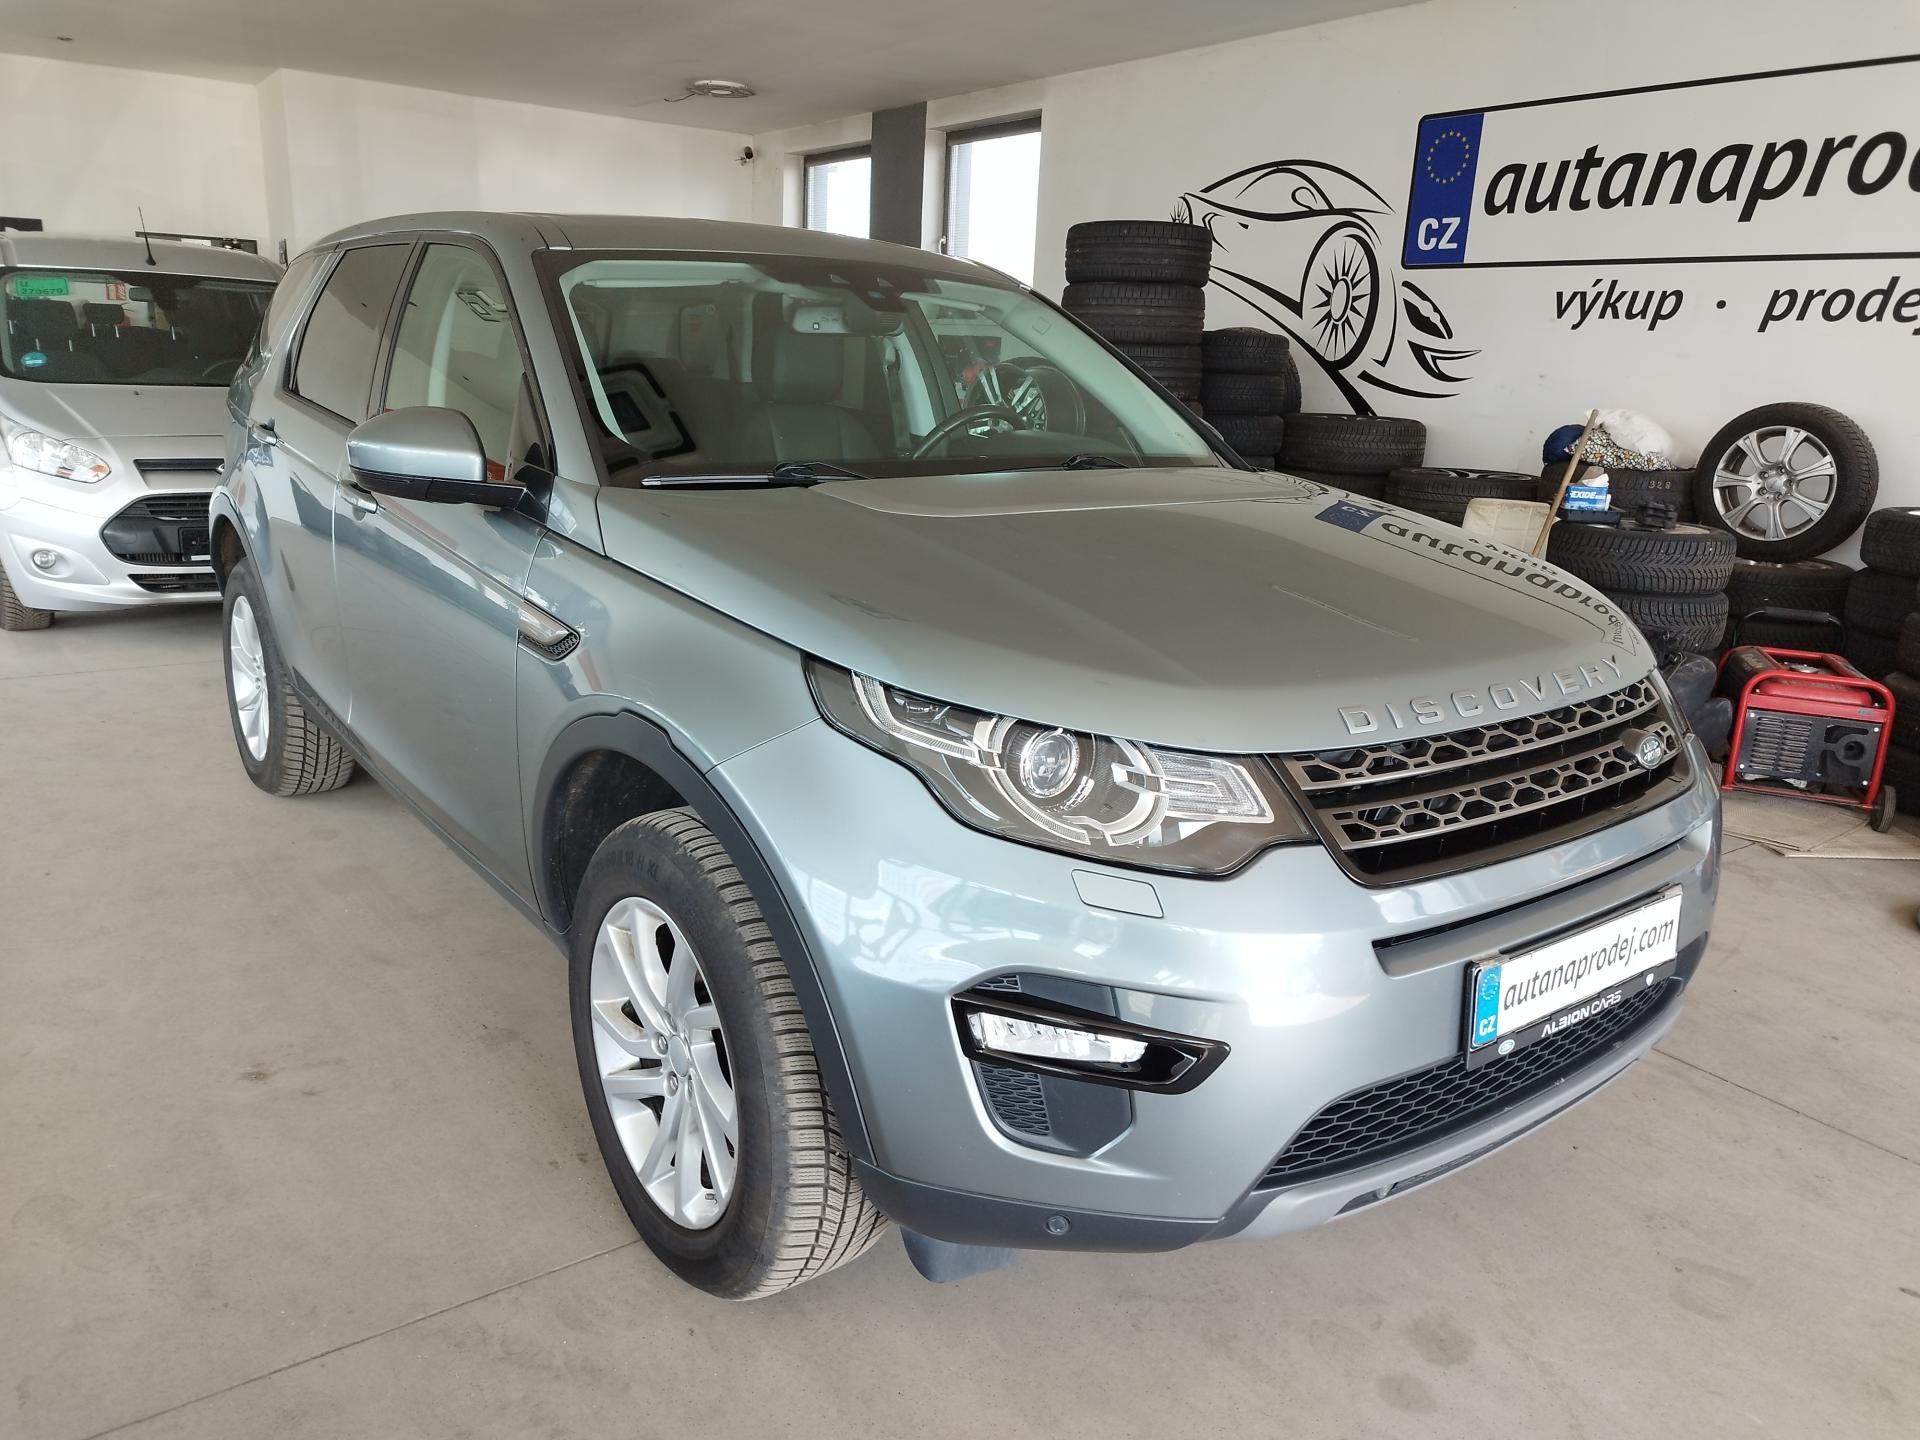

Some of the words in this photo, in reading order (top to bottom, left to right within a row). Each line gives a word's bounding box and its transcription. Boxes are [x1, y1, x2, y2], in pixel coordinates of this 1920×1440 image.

[1484, 130, 1920, 223] autanapro
[1417, 216, 1461, 251] CZ
[1555, 278, 1684, 331] výkup
[1757, 276, 1920, 335] prode
[1570, 490, 1597, 499] EXIDE
[1338, 655, 1622, 735] DISCOVERY
[1503, 918, 1674, 1011] autanaprodej.com
[1478, 1014, 1496, 1037] CZ
[1541, 1006, 1591, 1038] ALBION
[1590, 989, 1622, 1015] CARS
